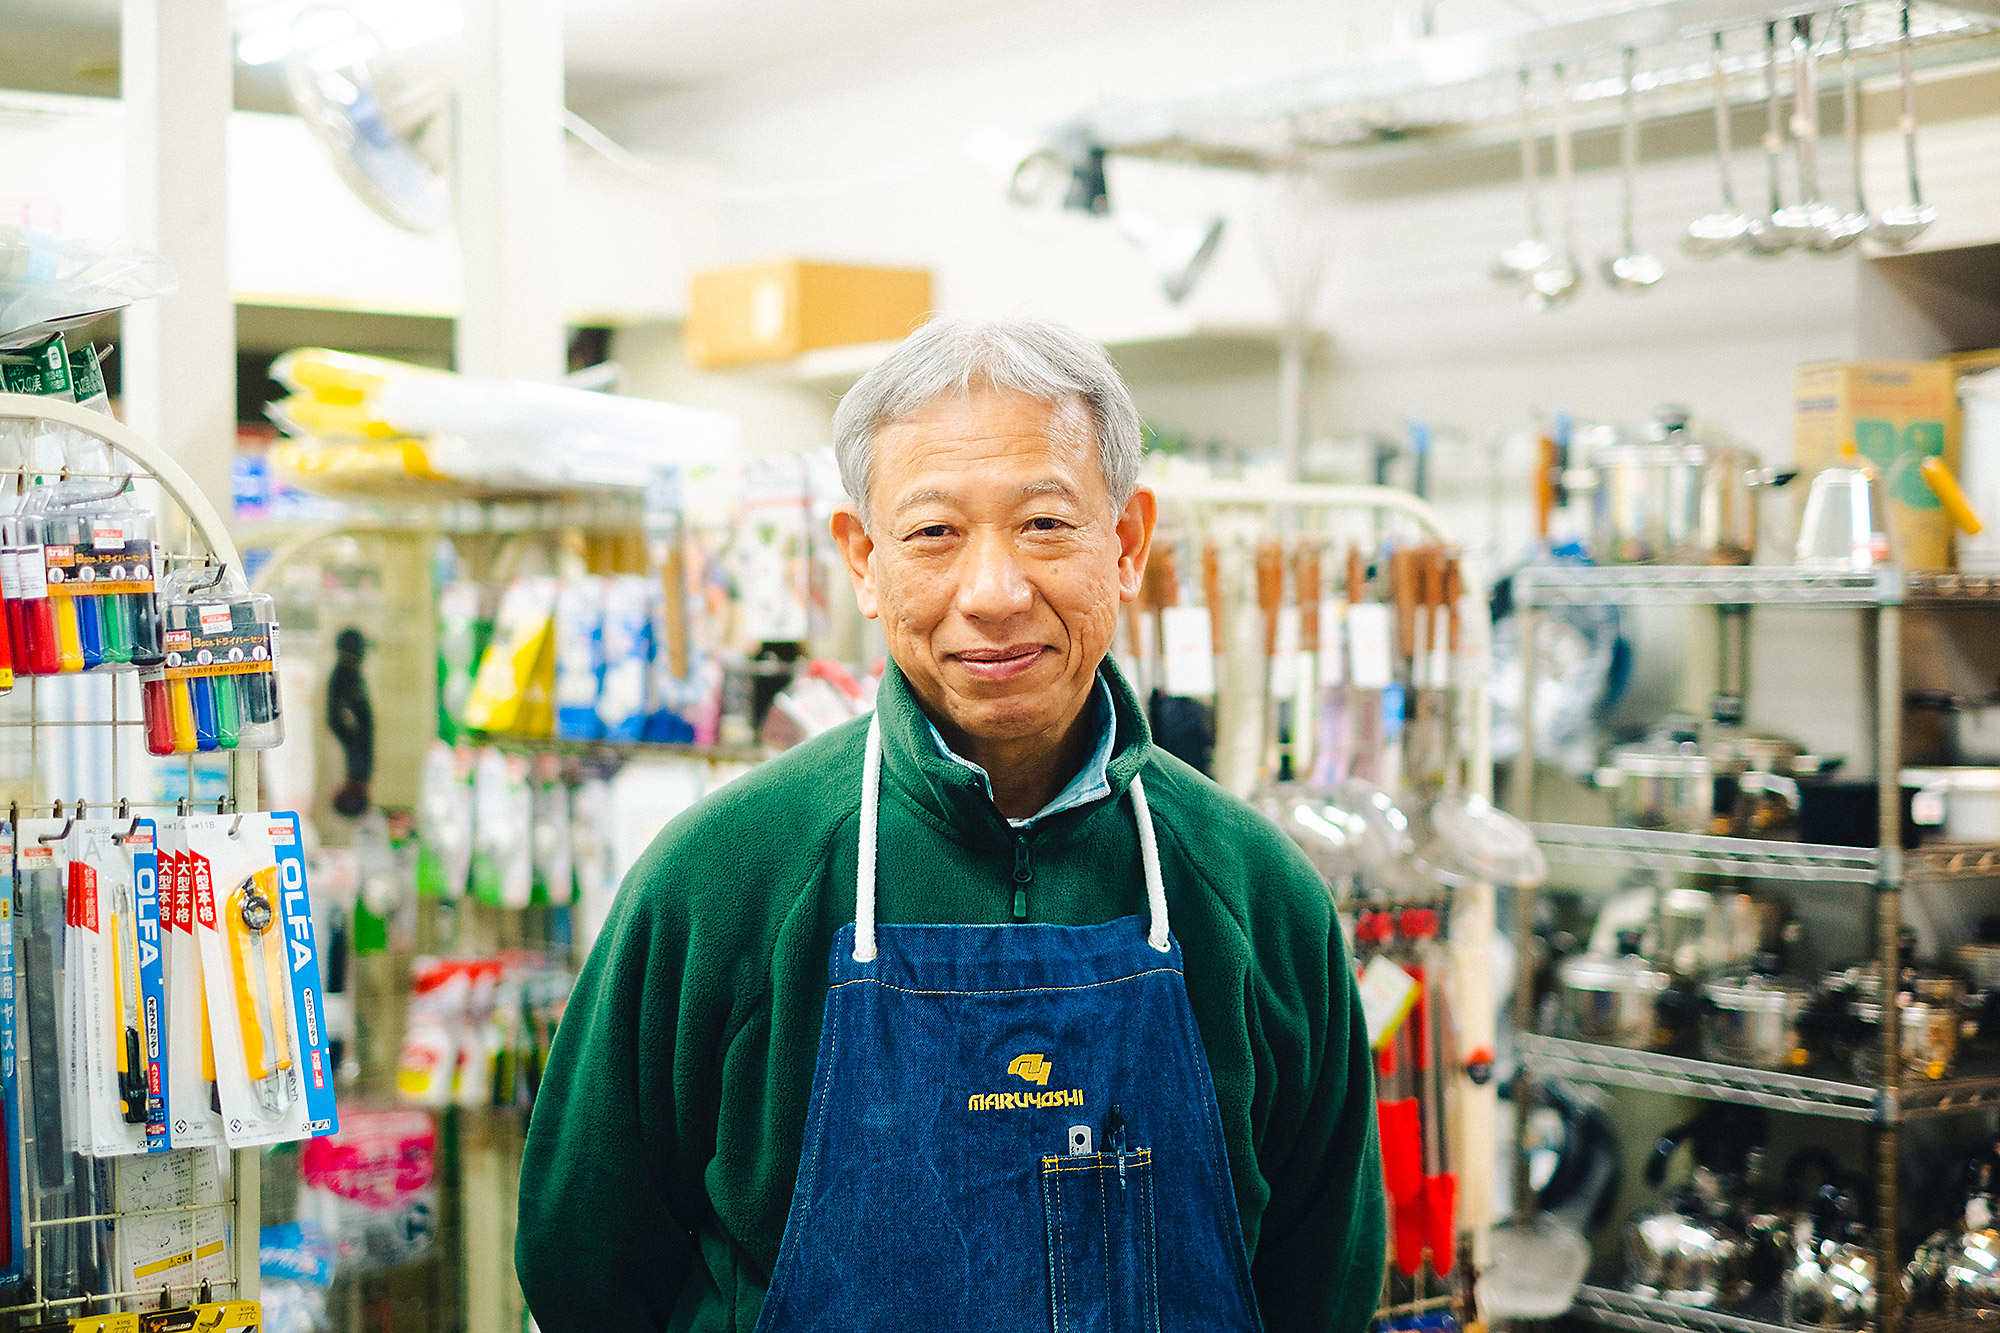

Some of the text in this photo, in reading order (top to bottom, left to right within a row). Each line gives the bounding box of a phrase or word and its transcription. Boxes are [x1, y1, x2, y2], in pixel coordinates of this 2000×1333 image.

[137, 868, 159, 969] OLFA
[176, 860, 192, 923] 大型本格
[194, 859, 214, 922] 大型本格
[281, 857, 313, 973] OLFA
[302, 1120, 330, 1132] OLFA
[967, 1088, 1085, 1111] MARUYOSHI
[138, 1137, 163, 1149] OLFA
